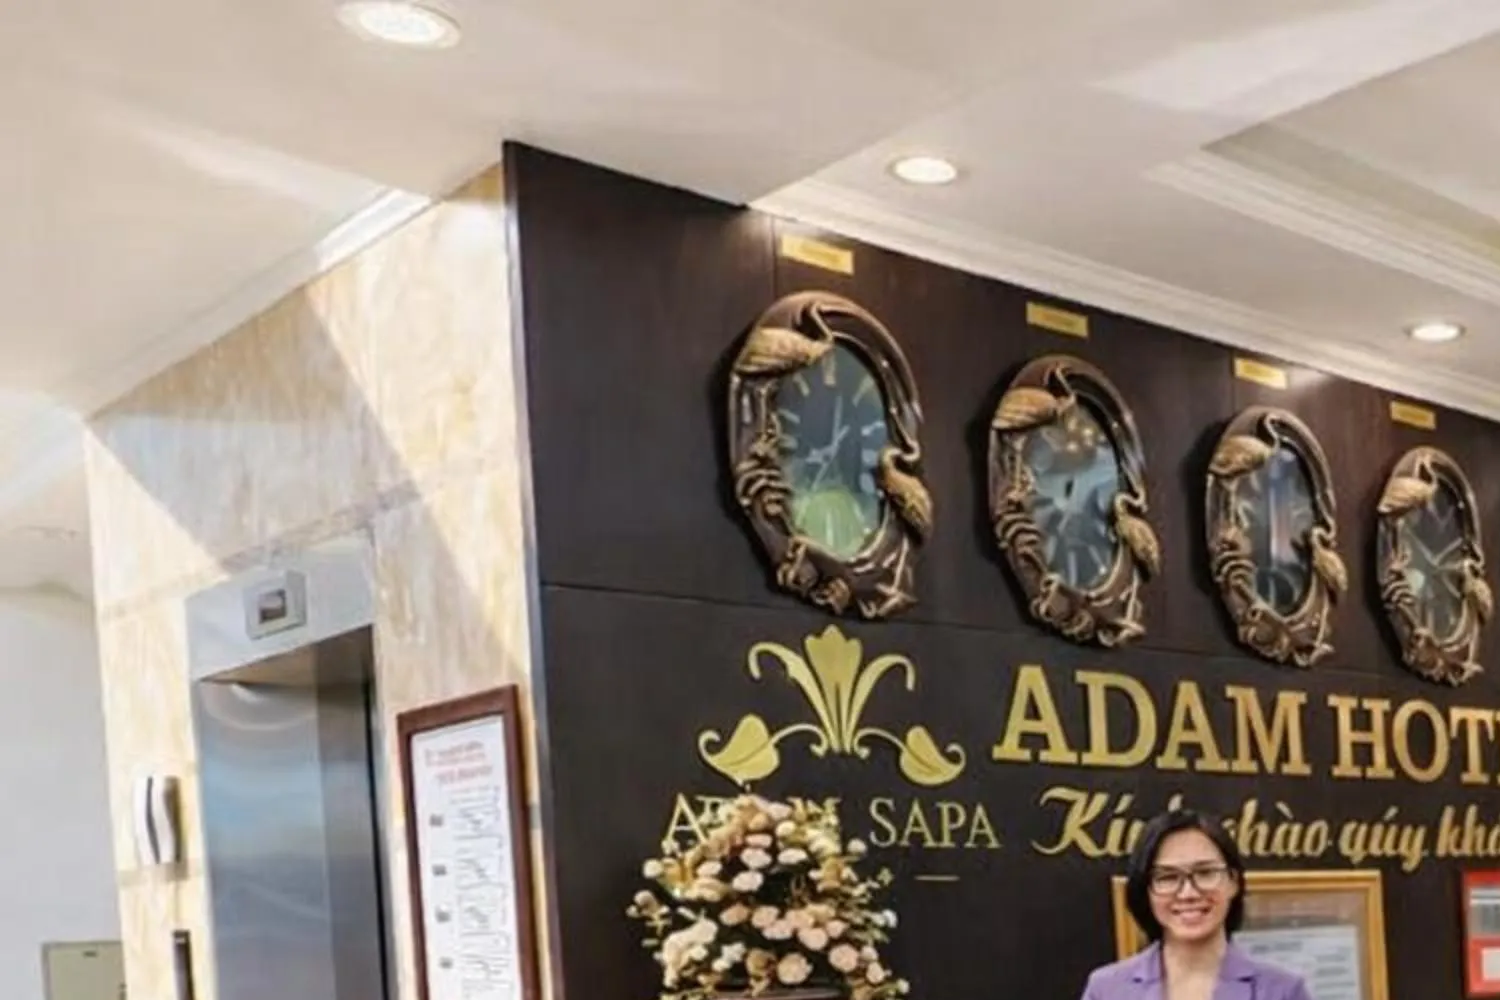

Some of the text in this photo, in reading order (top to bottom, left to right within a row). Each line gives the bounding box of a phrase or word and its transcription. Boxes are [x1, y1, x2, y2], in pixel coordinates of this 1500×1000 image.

[993, 665, 1311, 775] ADAM
[869, 798, 1001, 849] SAPA
[1032, 786, 1183, 858] Kí
